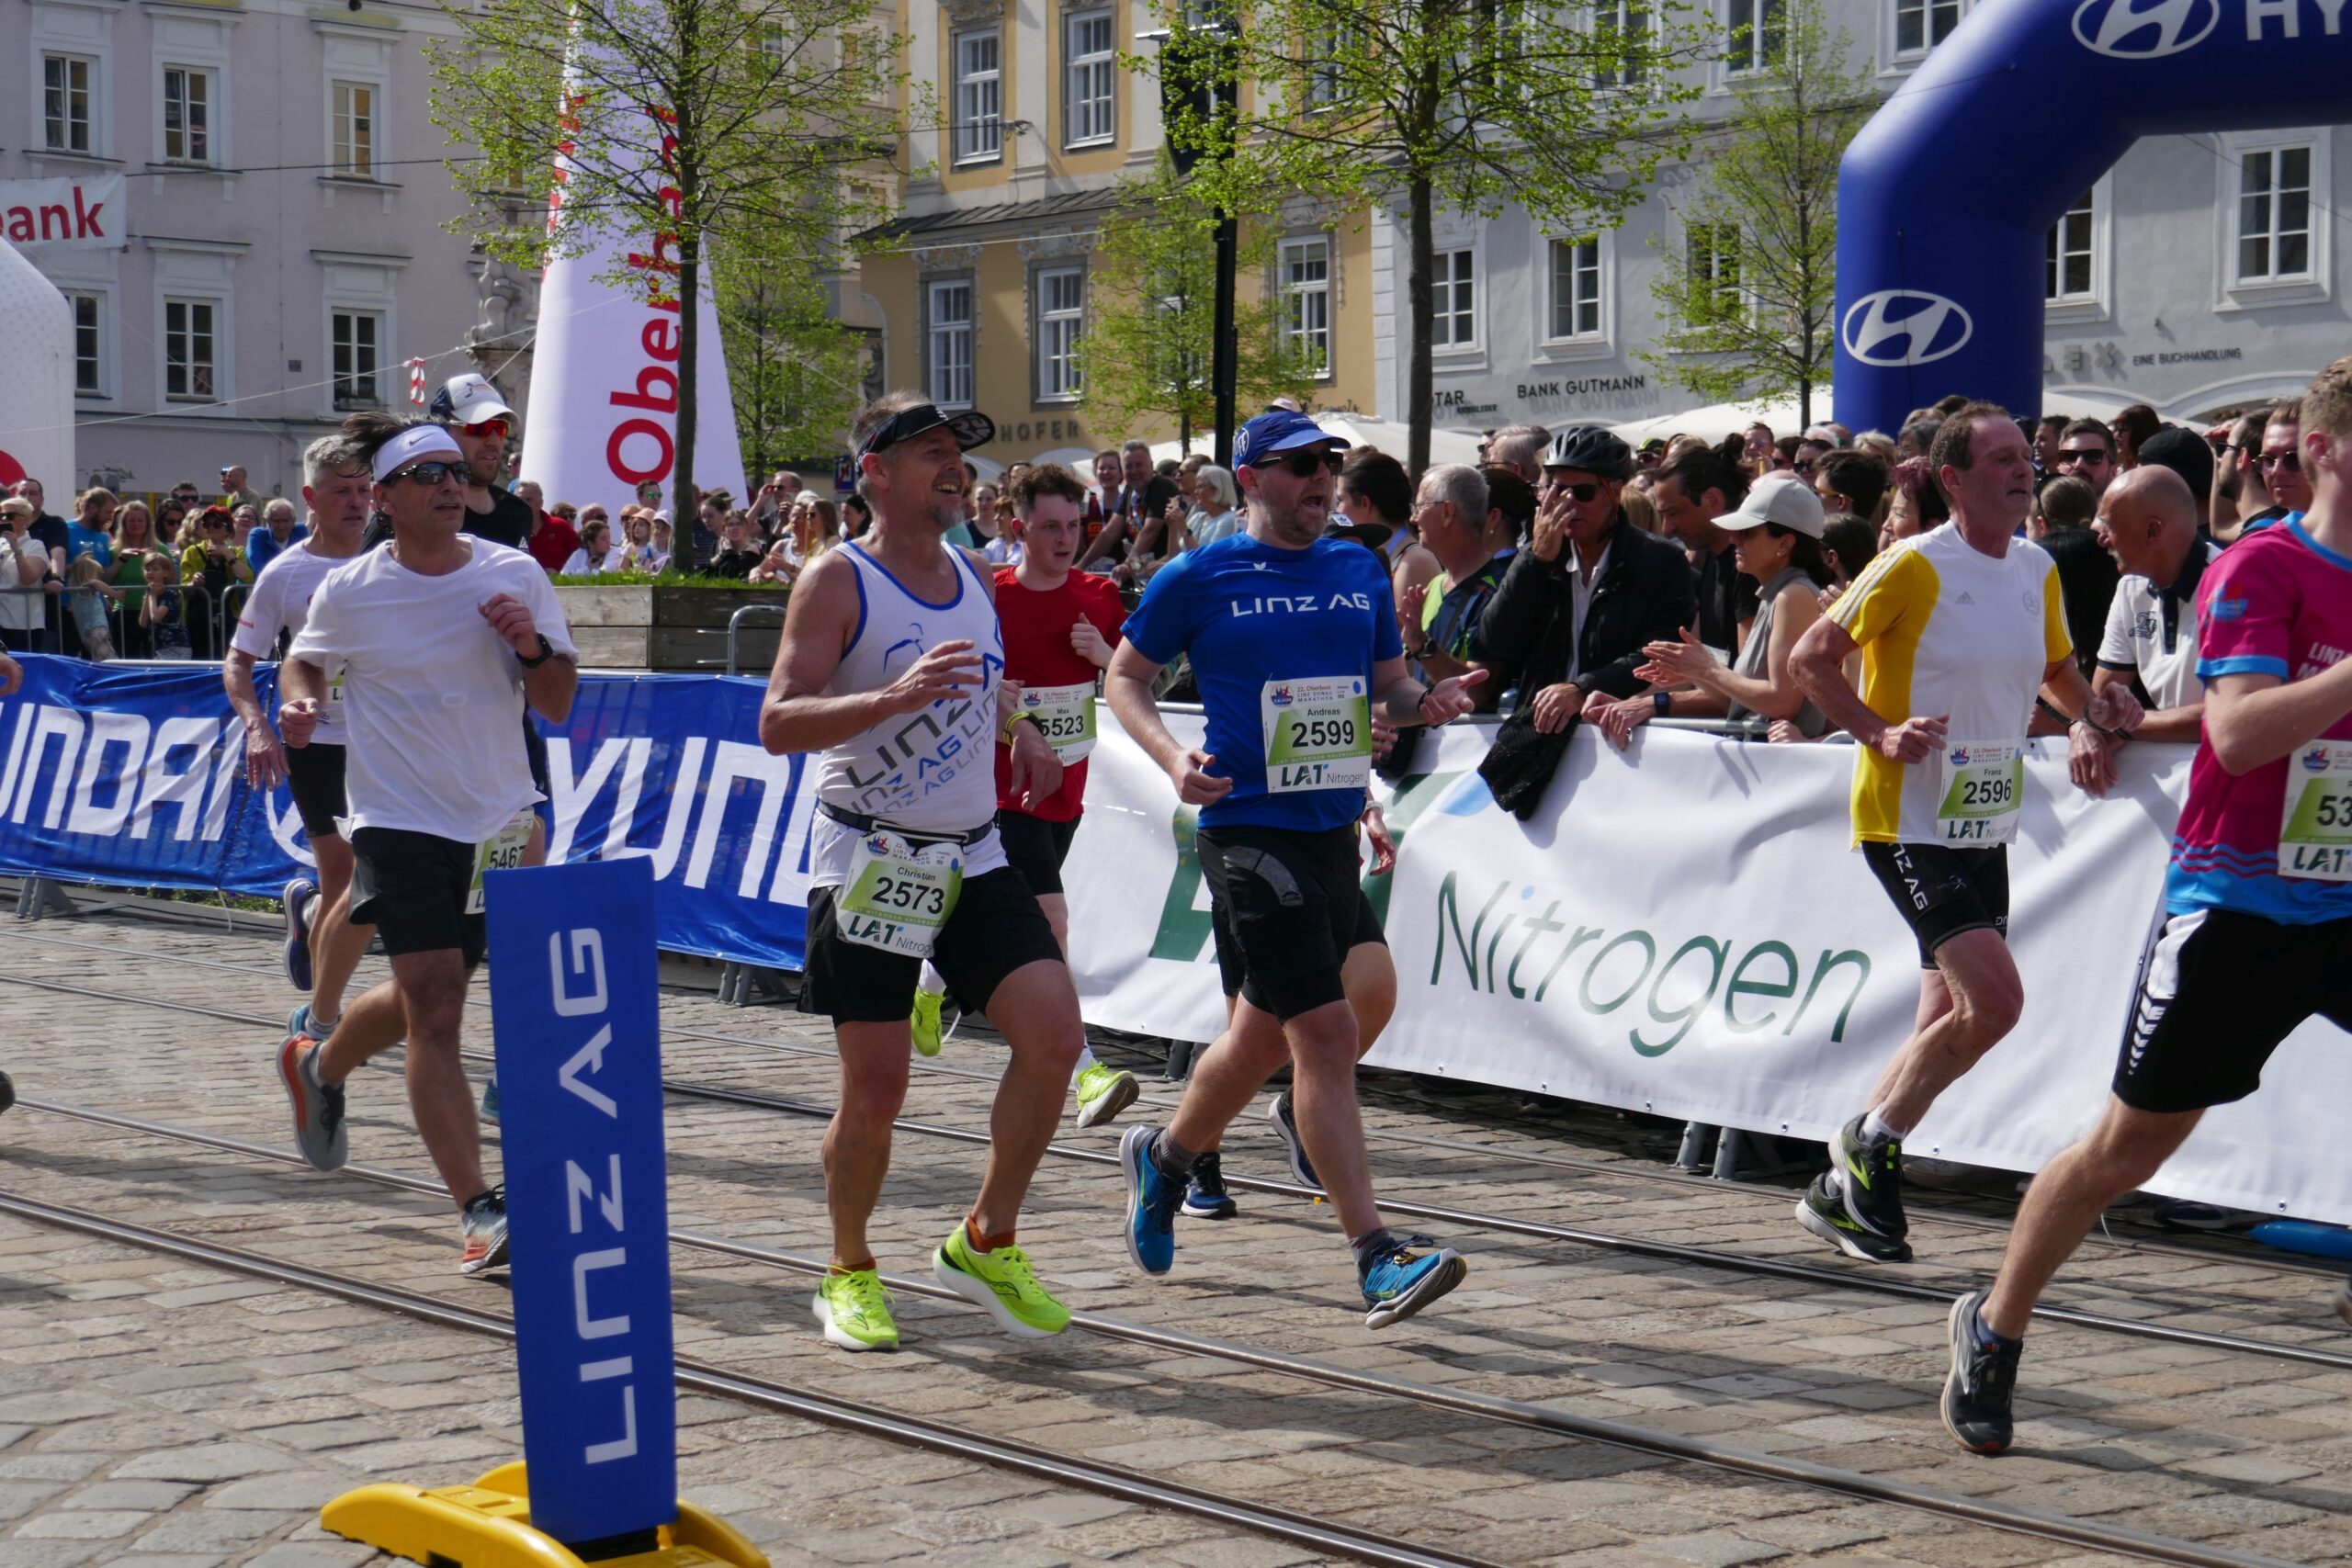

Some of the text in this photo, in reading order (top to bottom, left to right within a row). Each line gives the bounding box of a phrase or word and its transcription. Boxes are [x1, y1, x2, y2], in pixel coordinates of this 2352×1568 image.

[0, 186, 105, 243] ank
[2132, 347, 2242, 367] EINE BUCHHANDLUNG
[1517, 375, 1645, 399] BANK GUTMANN
[1231, 592, 1370, 618] LINZ AG
[1039, 715, 1084, 737] 5523
[1306, 708, 1341, 717] Andreas
[844, 683, 972, 789] LINZ
[1291, 719, 1355, 749] 2599
[919, 734, 963, 780] AG
[923, 765, 956, 796] AG
[1281, 763, 1363, 787] LAT Nitrogen
[1984, 768, 2002, 776] Franz
[1962, 778, 2012, 805] 2596
[500, 835, 516, 844] Gerald
[1947, 819, 1985, 840] LAT
[2293, 845, 2346, 874] LAT
[897, 866, 936, 882] Christian
[871, 876, 945, 915] 2573
[1904, 877, 1928, 911] AG
[847, 915, 898, 945] LAT
[1430, 869, 1872, 1058] Nitrogen
[550, 926, 639, 1466] LINZ AG
